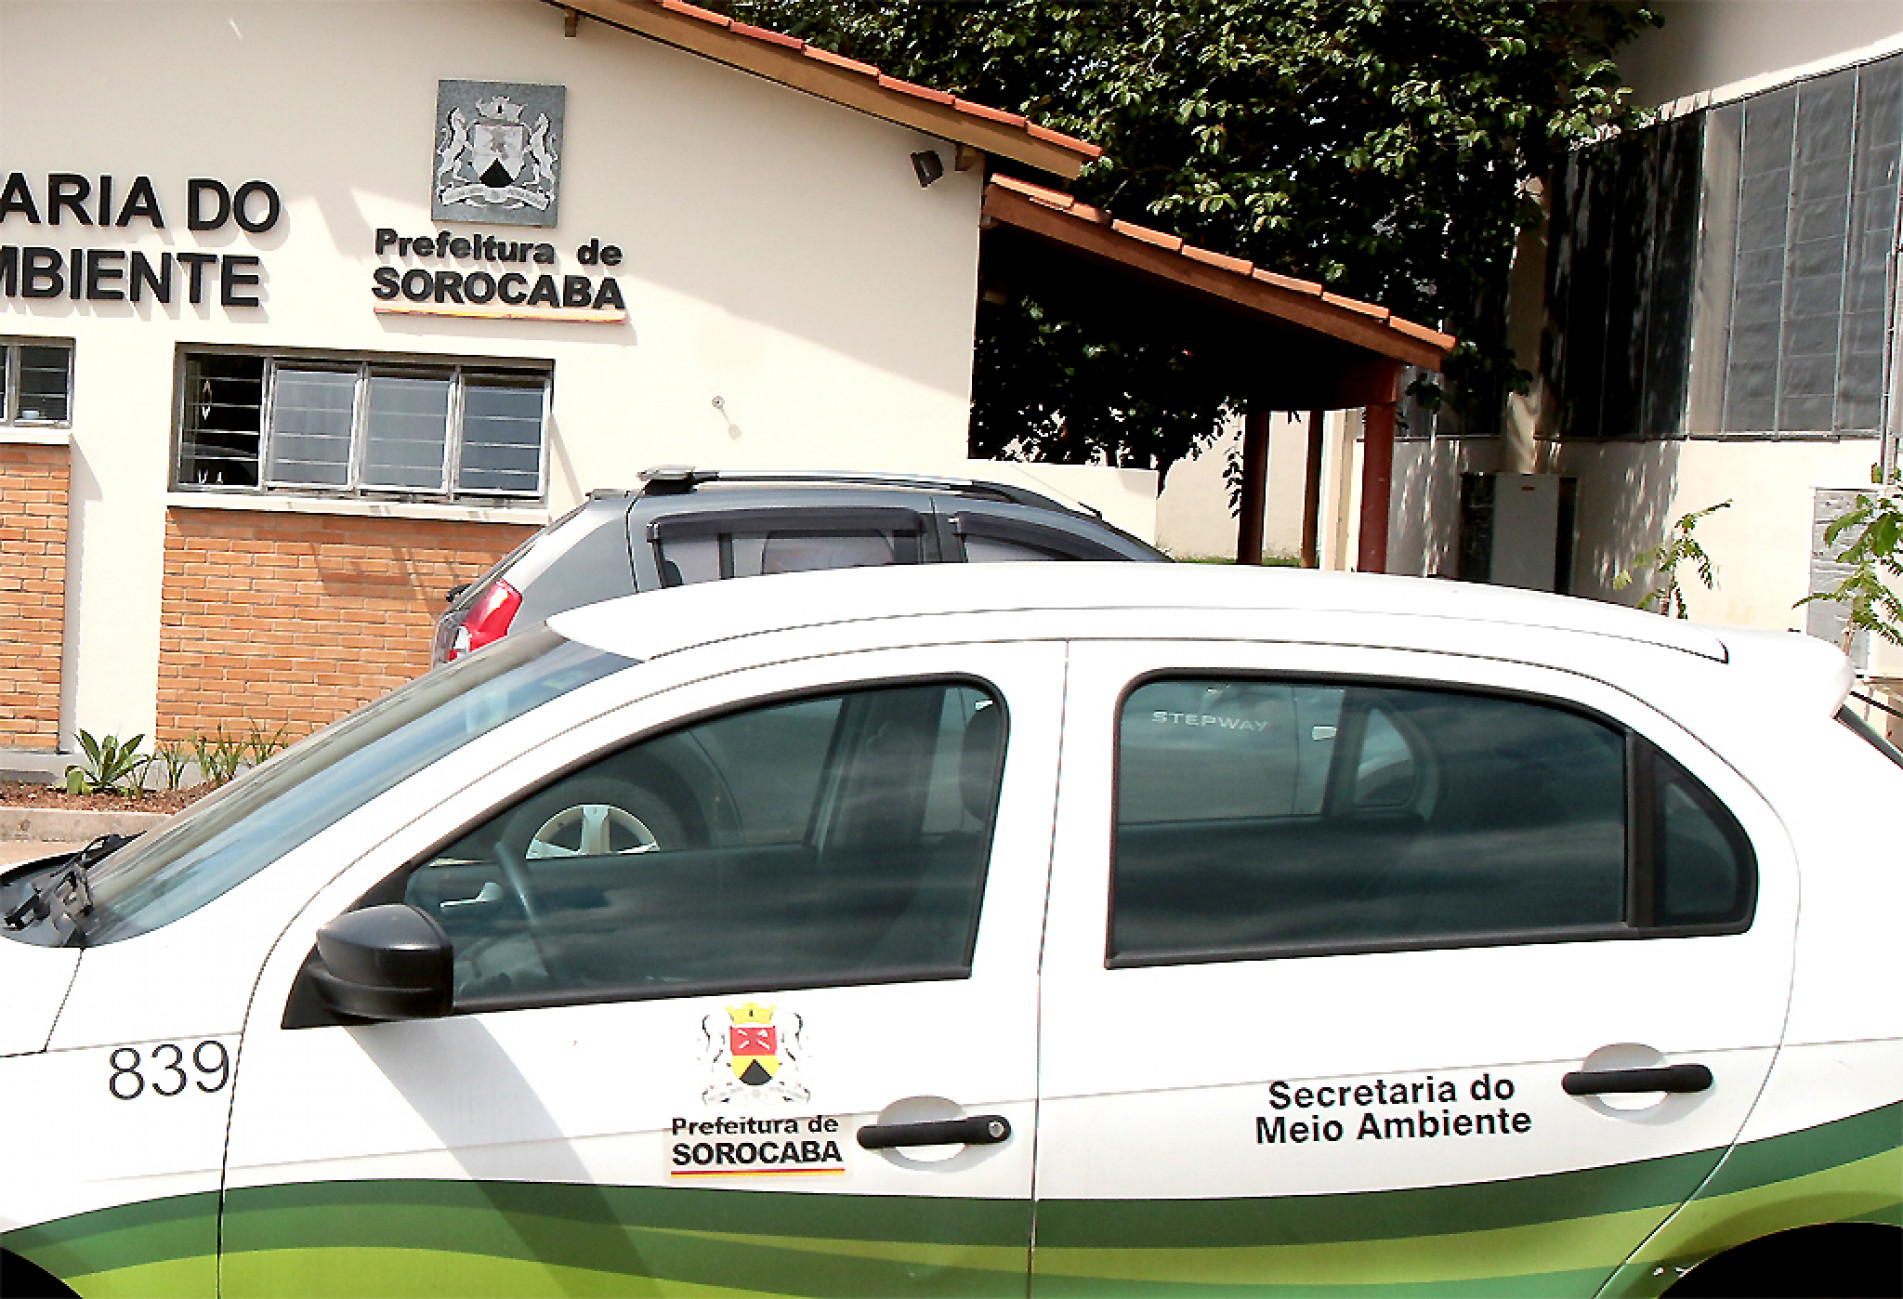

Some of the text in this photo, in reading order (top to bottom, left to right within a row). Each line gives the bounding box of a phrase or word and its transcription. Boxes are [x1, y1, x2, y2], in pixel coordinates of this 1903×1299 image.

[0, 171, 281, 233] ARIA DO
[577, 237, 623, 265] de
[371, 266, 625, 309] SOROCABA
[1151, 710, 1268, 732] STEPWAY
[109, 1040, 229, 1101] 839
[1268, 1073, 1515, 1110] Secretaria do
[671, 1114, 839, 1136] Prefeitura de
[1256, 1107, 1532, 1145] Meio Ambiente
[672, 1140, 843, 1167] SOROCABA
